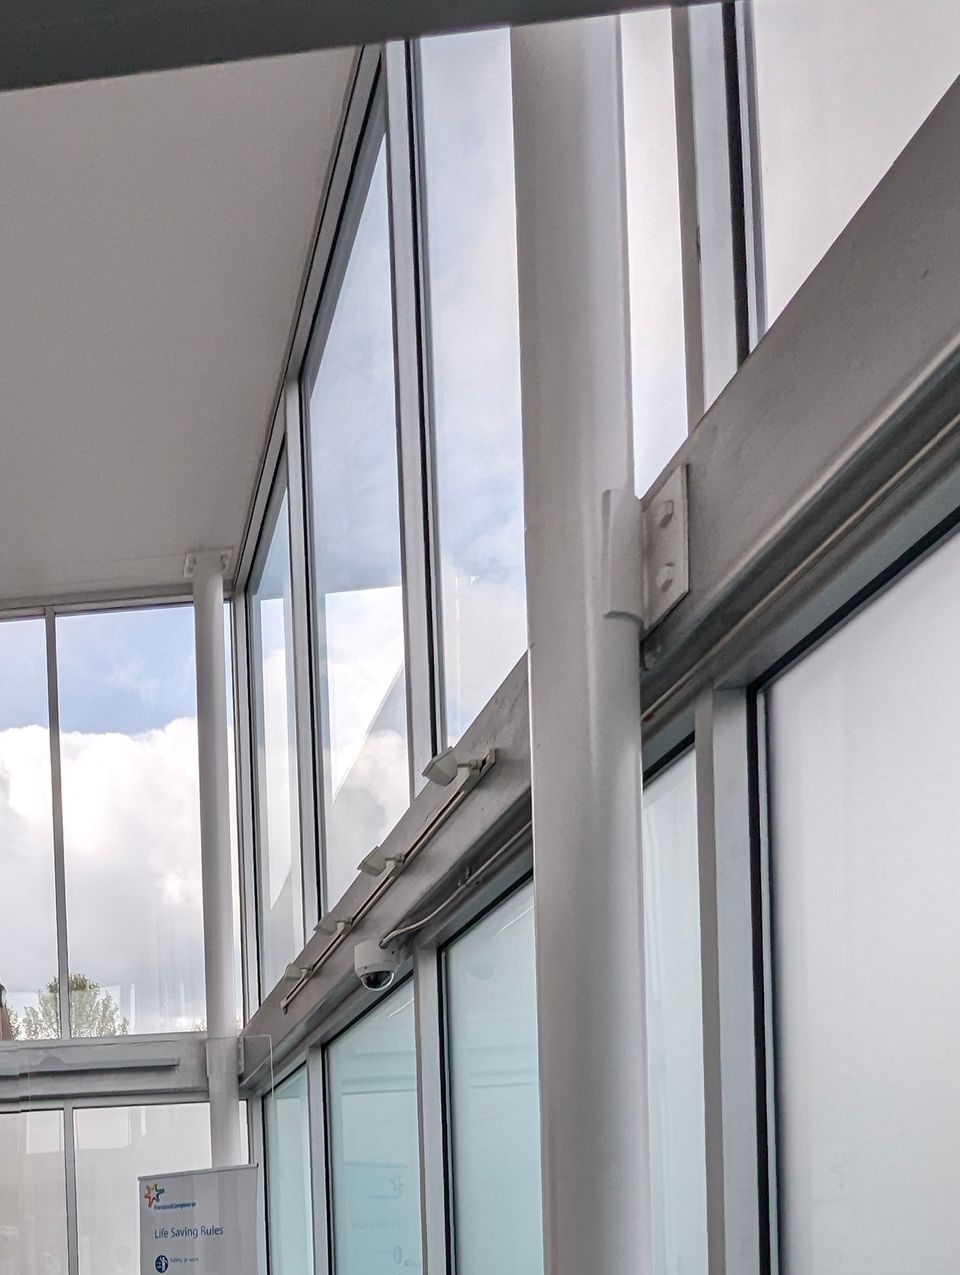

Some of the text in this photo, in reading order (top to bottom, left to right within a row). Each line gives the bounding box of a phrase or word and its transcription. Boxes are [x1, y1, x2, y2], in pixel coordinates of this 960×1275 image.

[155, 1224, 224, 1239] Life Saving Rules
